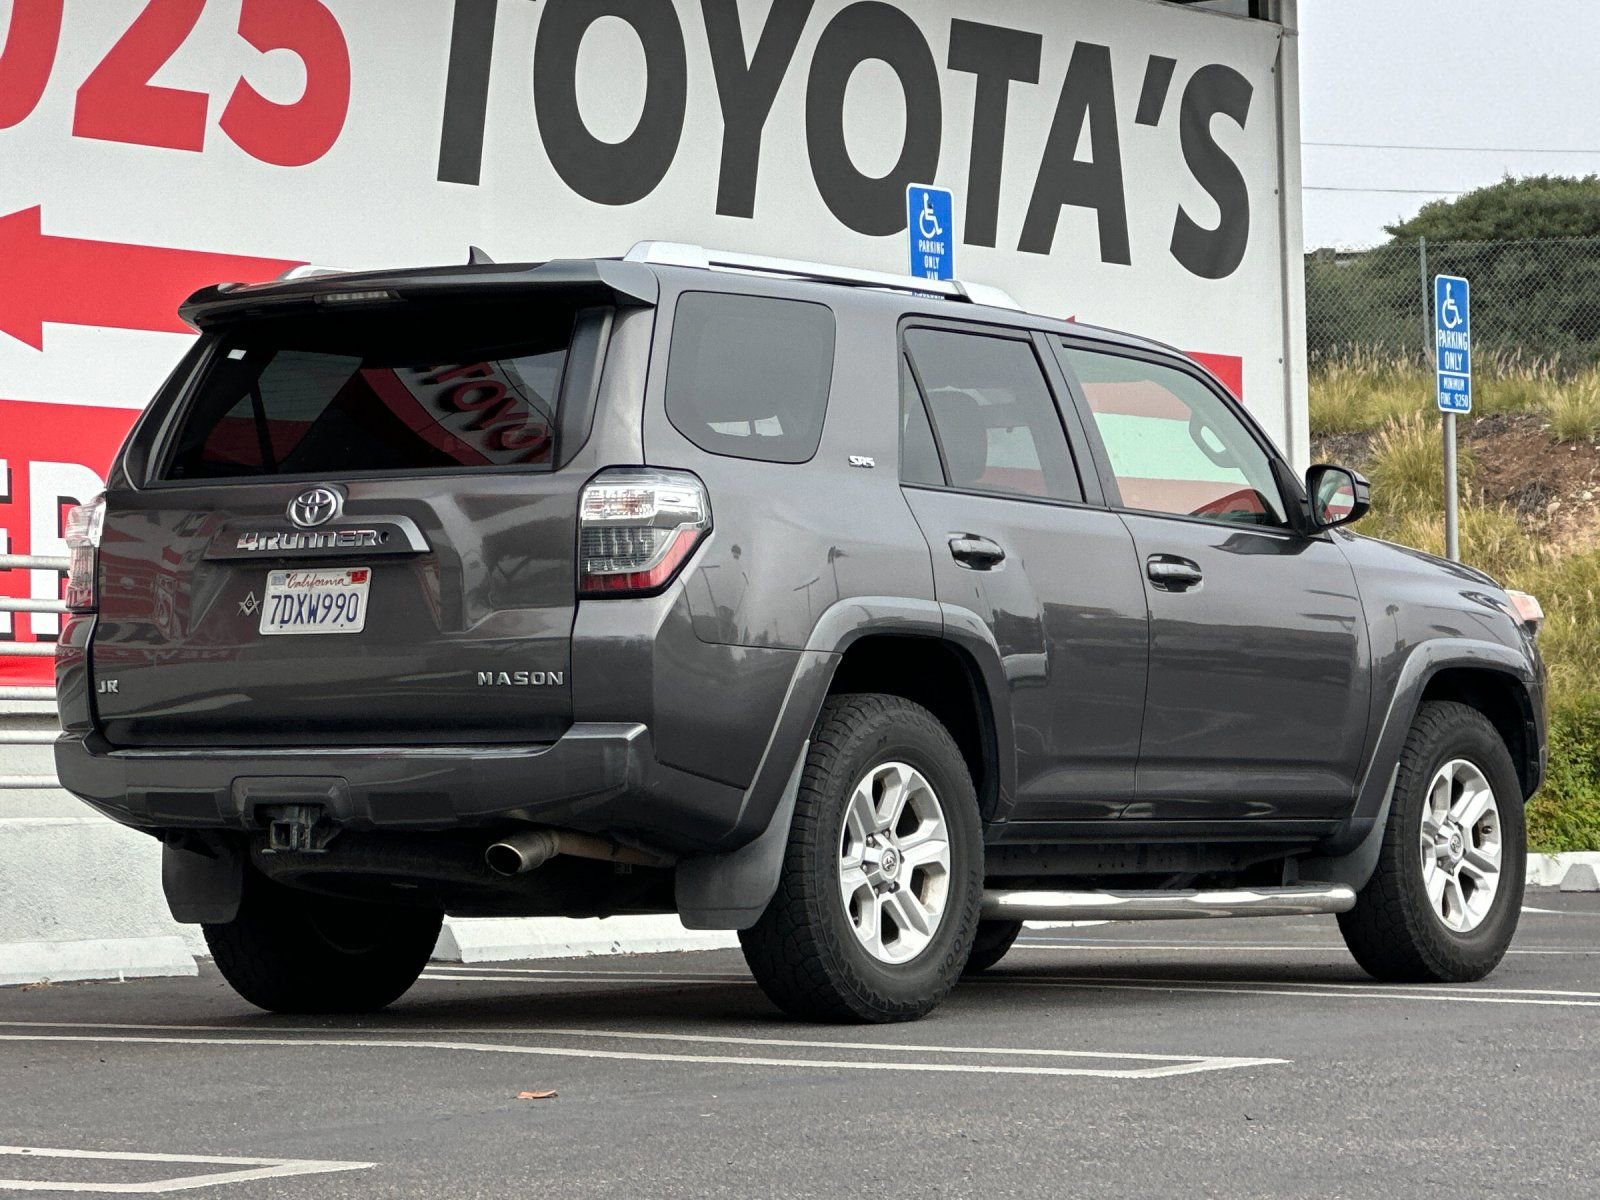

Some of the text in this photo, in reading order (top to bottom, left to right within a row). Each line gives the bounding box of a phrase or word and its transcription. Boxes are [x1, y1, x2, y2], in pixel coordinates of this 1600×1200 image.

[918, 239, 945, 256] PARKING
[923, 255, 940, 269] ONLY
[1438, 329, 1468, 350] PARKING
[1444, 351, 1463, 371] ONLY
[1443, 377, 1465, 391] MINIMUM
[1440, 392, 1468, 408] FINE $250
[236, 530, 377, 551] 4RUNNER
[287, 572, 348, 591] California
[270, 593, 360, 625] 7DXW990
[98, 679, 119, 693] JR
[477, 671, 564, 686] MASON
